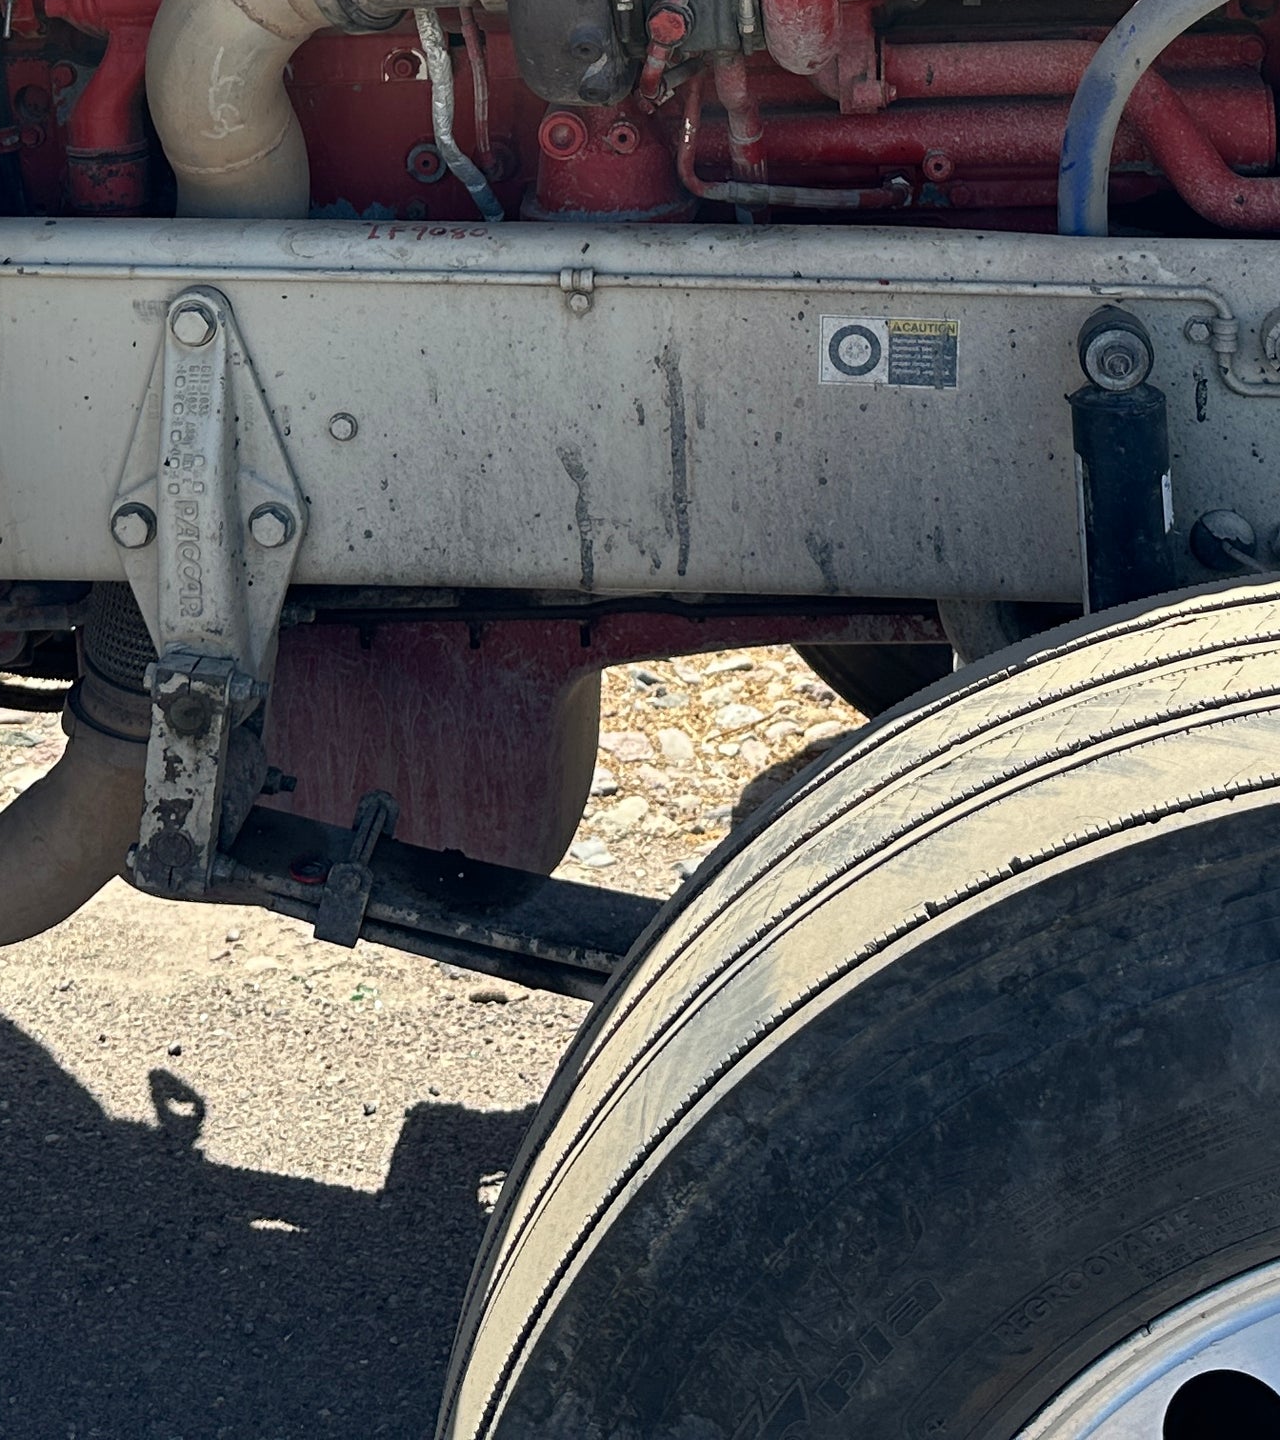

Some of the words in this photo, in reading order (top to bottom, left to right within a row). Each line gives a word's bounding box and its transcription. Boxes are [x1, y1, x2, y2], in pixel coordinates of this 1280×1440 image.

[903, 322, 956, 334] CAUTION
[174, 500, 205, 618] PACCAR
[991, 1201, 1197, 1352] REGROOVABLE
